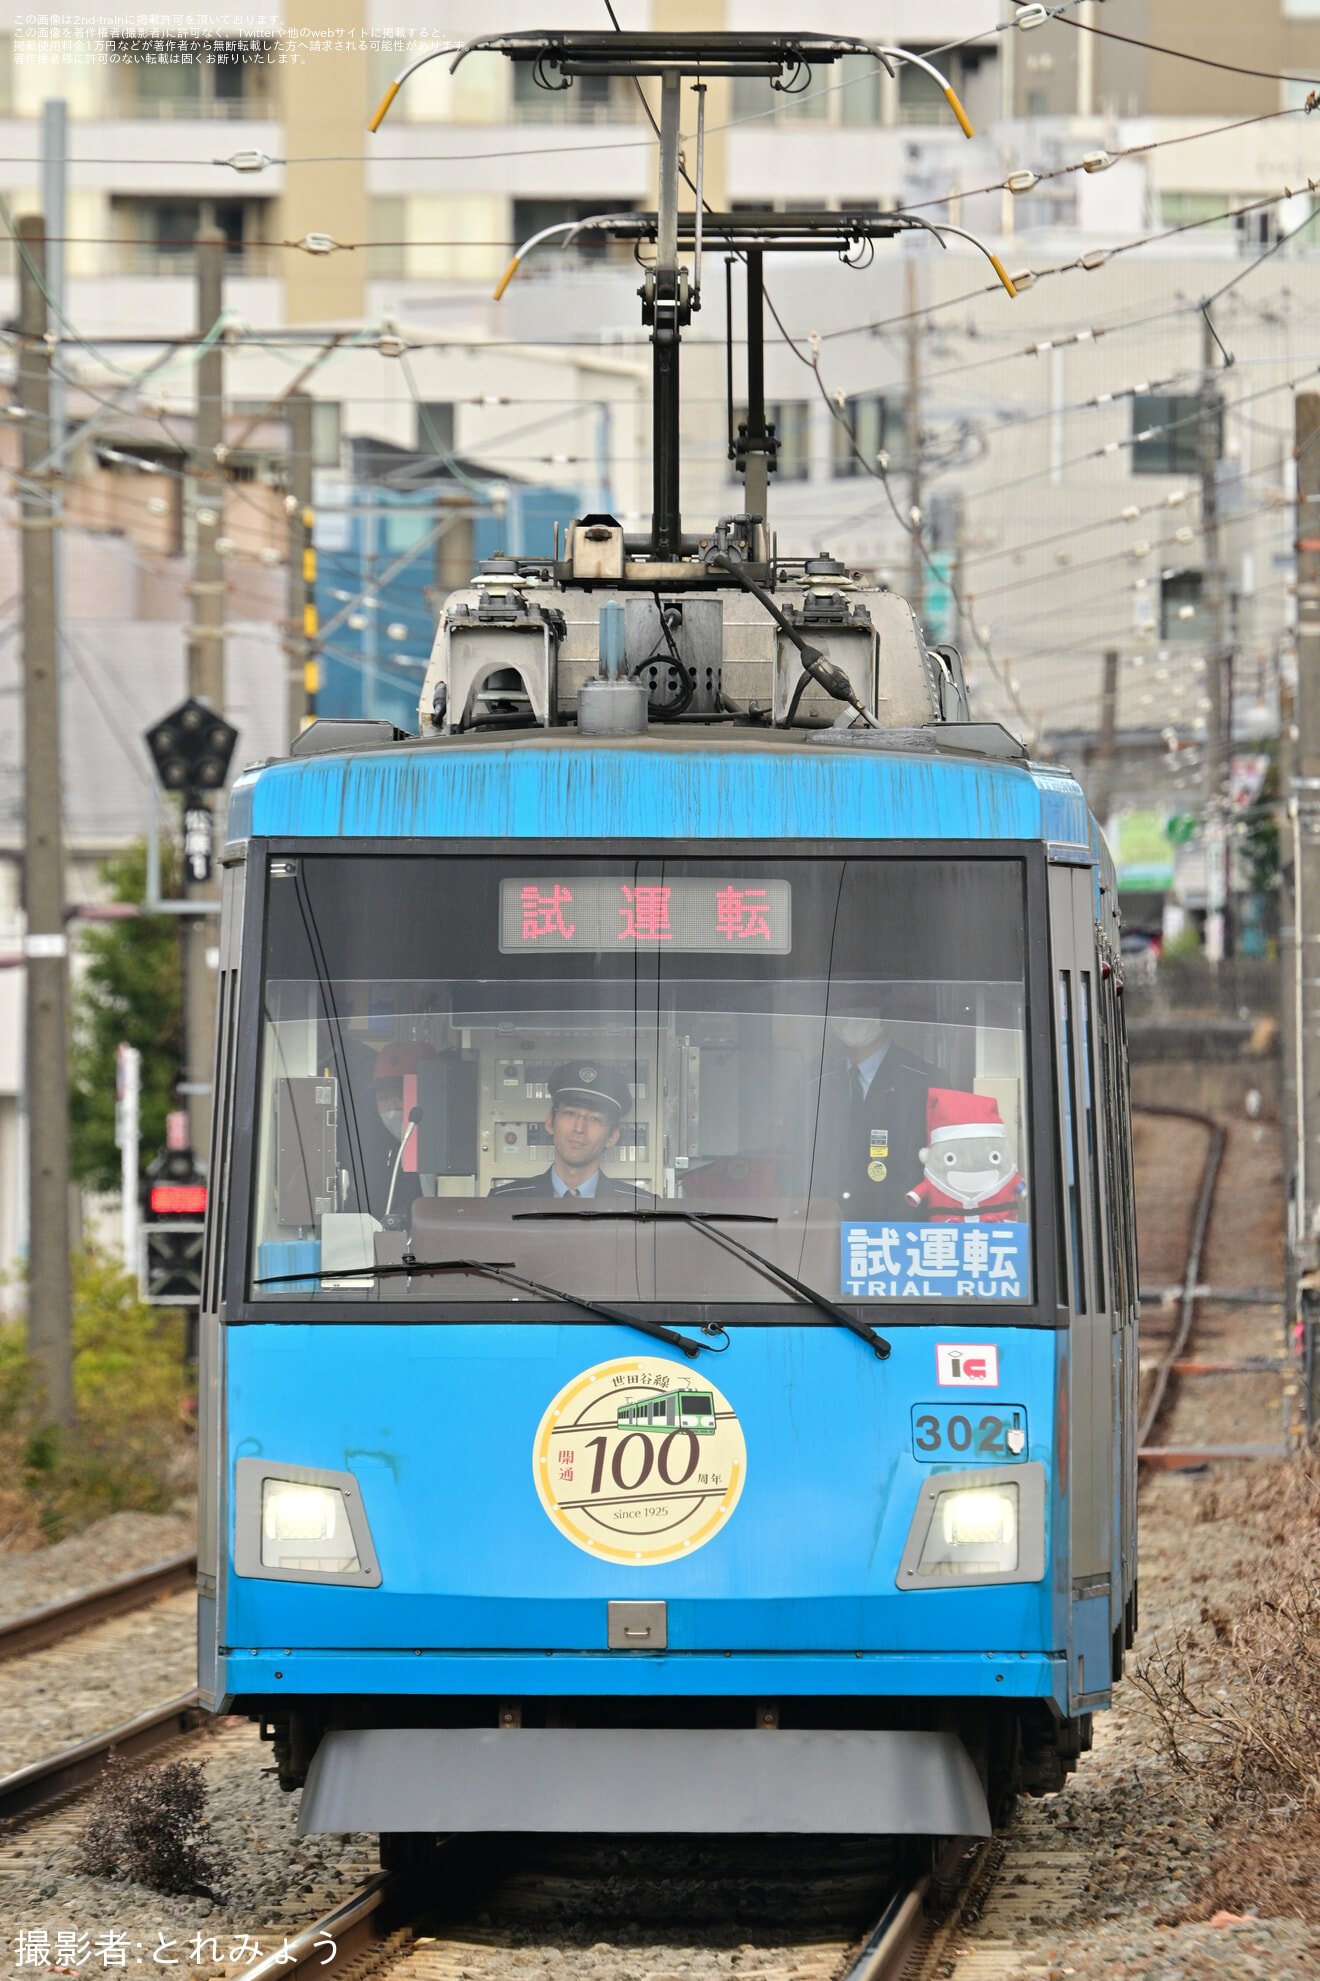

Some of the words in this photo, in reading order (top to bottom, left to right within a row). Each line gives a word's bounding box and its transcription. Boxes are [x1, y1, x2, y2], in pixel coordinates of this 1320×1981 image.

[520, 884, 771, 940] 試運転
[847, 1227, 1018, 1280] 試運転
[846, 1280, 942, 1297] TRIAL
[956, 1280, 1021, 1297] RUN
[610, 1373, 671, 1388] 世田谷線
[915, 1415, 1005, 1452] 302
[558, 1450, 575, 1482] 開通
[584, 1428, 700, 1494] 100
[613, 1508, 642, 1520] since
[644, 1506, 669, 1518] 1925
